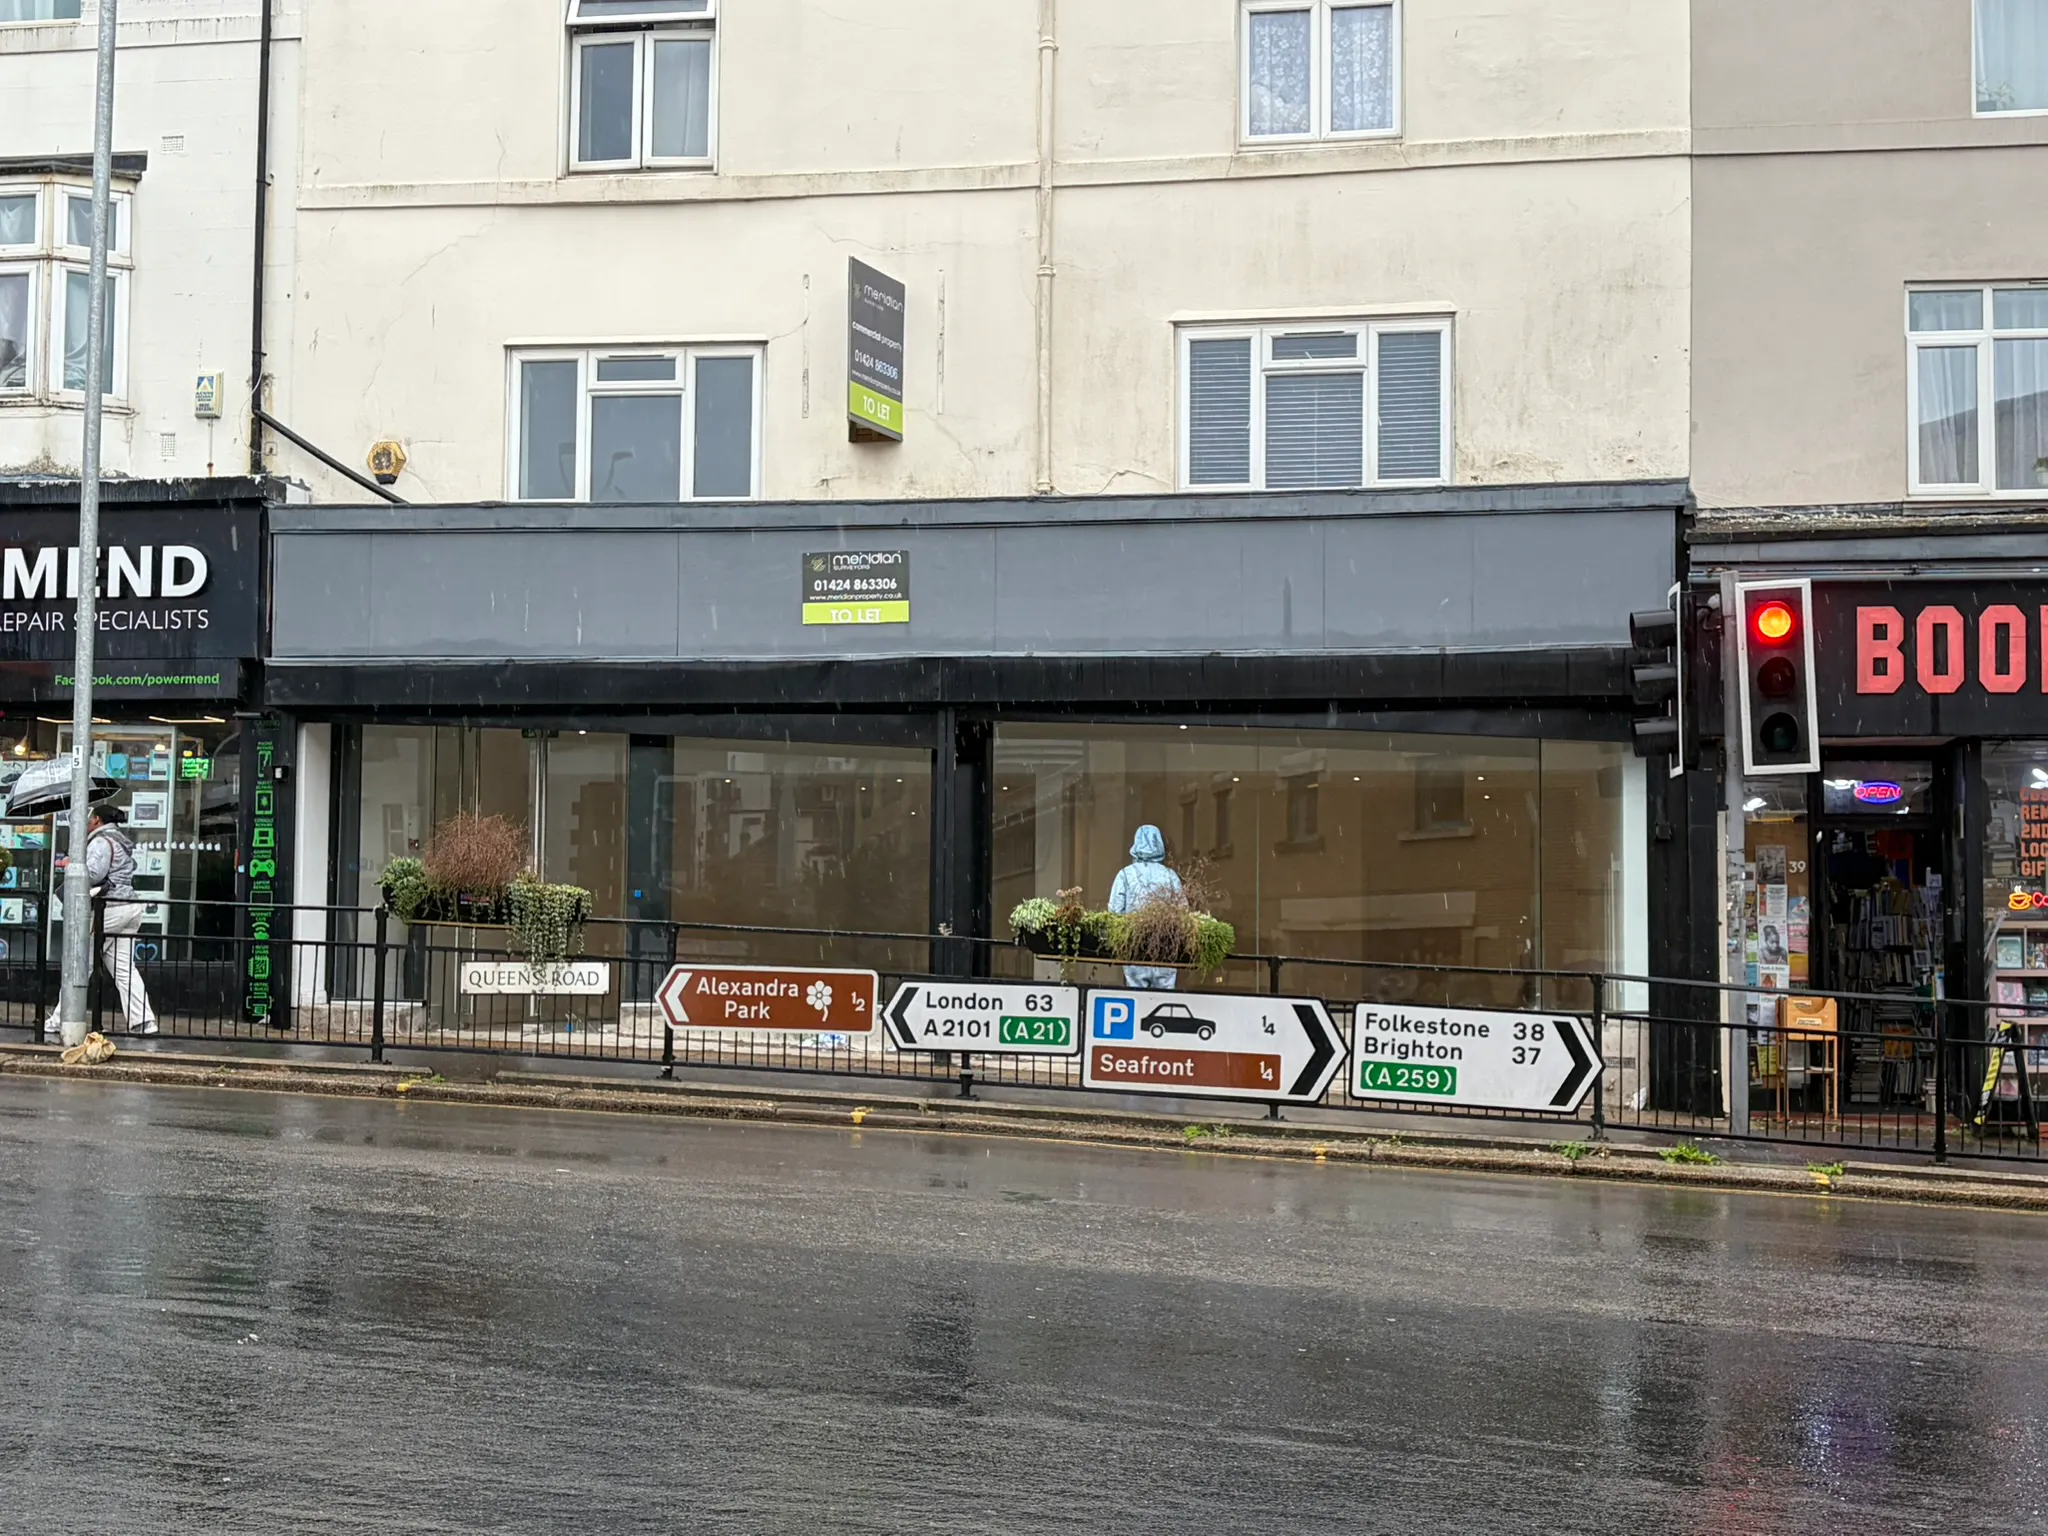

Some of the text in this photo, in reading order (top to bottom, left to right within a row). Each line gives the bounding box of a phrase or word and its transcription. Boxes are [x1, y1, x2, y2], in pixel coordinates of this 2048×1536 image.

[864, 284, 904, 314] meridian
[862, 395, 890, 421] TO LET
[832, 552, 902, 565] meridian
[814, 577, 898, 591] 01424 863306
[0, 608, 209, 632] EPAIR ECIALISTS
[830, 606, 882, 624] TO LET
[1856, 604, 2048, 694] BOO
[1854, 786, 1903, 799] OPEN
[2020, 822, 2048, 839] 2ND
[1788, 860, 1807, 874] 39
[469, 970, 600, 988] QUEENS ROAD
[695, 976, 800, 998] Alexandra
[724, 1000, 771, 1020] Park
[925, 990, 1054, 1012] London 63
[1103, 1001, 1128, 1036] P
[1365, 1012, 1546, 1042] Folkestone 38
[1363, 1036, 1542, 1066] Brighton 37
[1099, 1053, 1195, 1079] Seafront
[1363, 1062, 1453, 1093] (A259)
